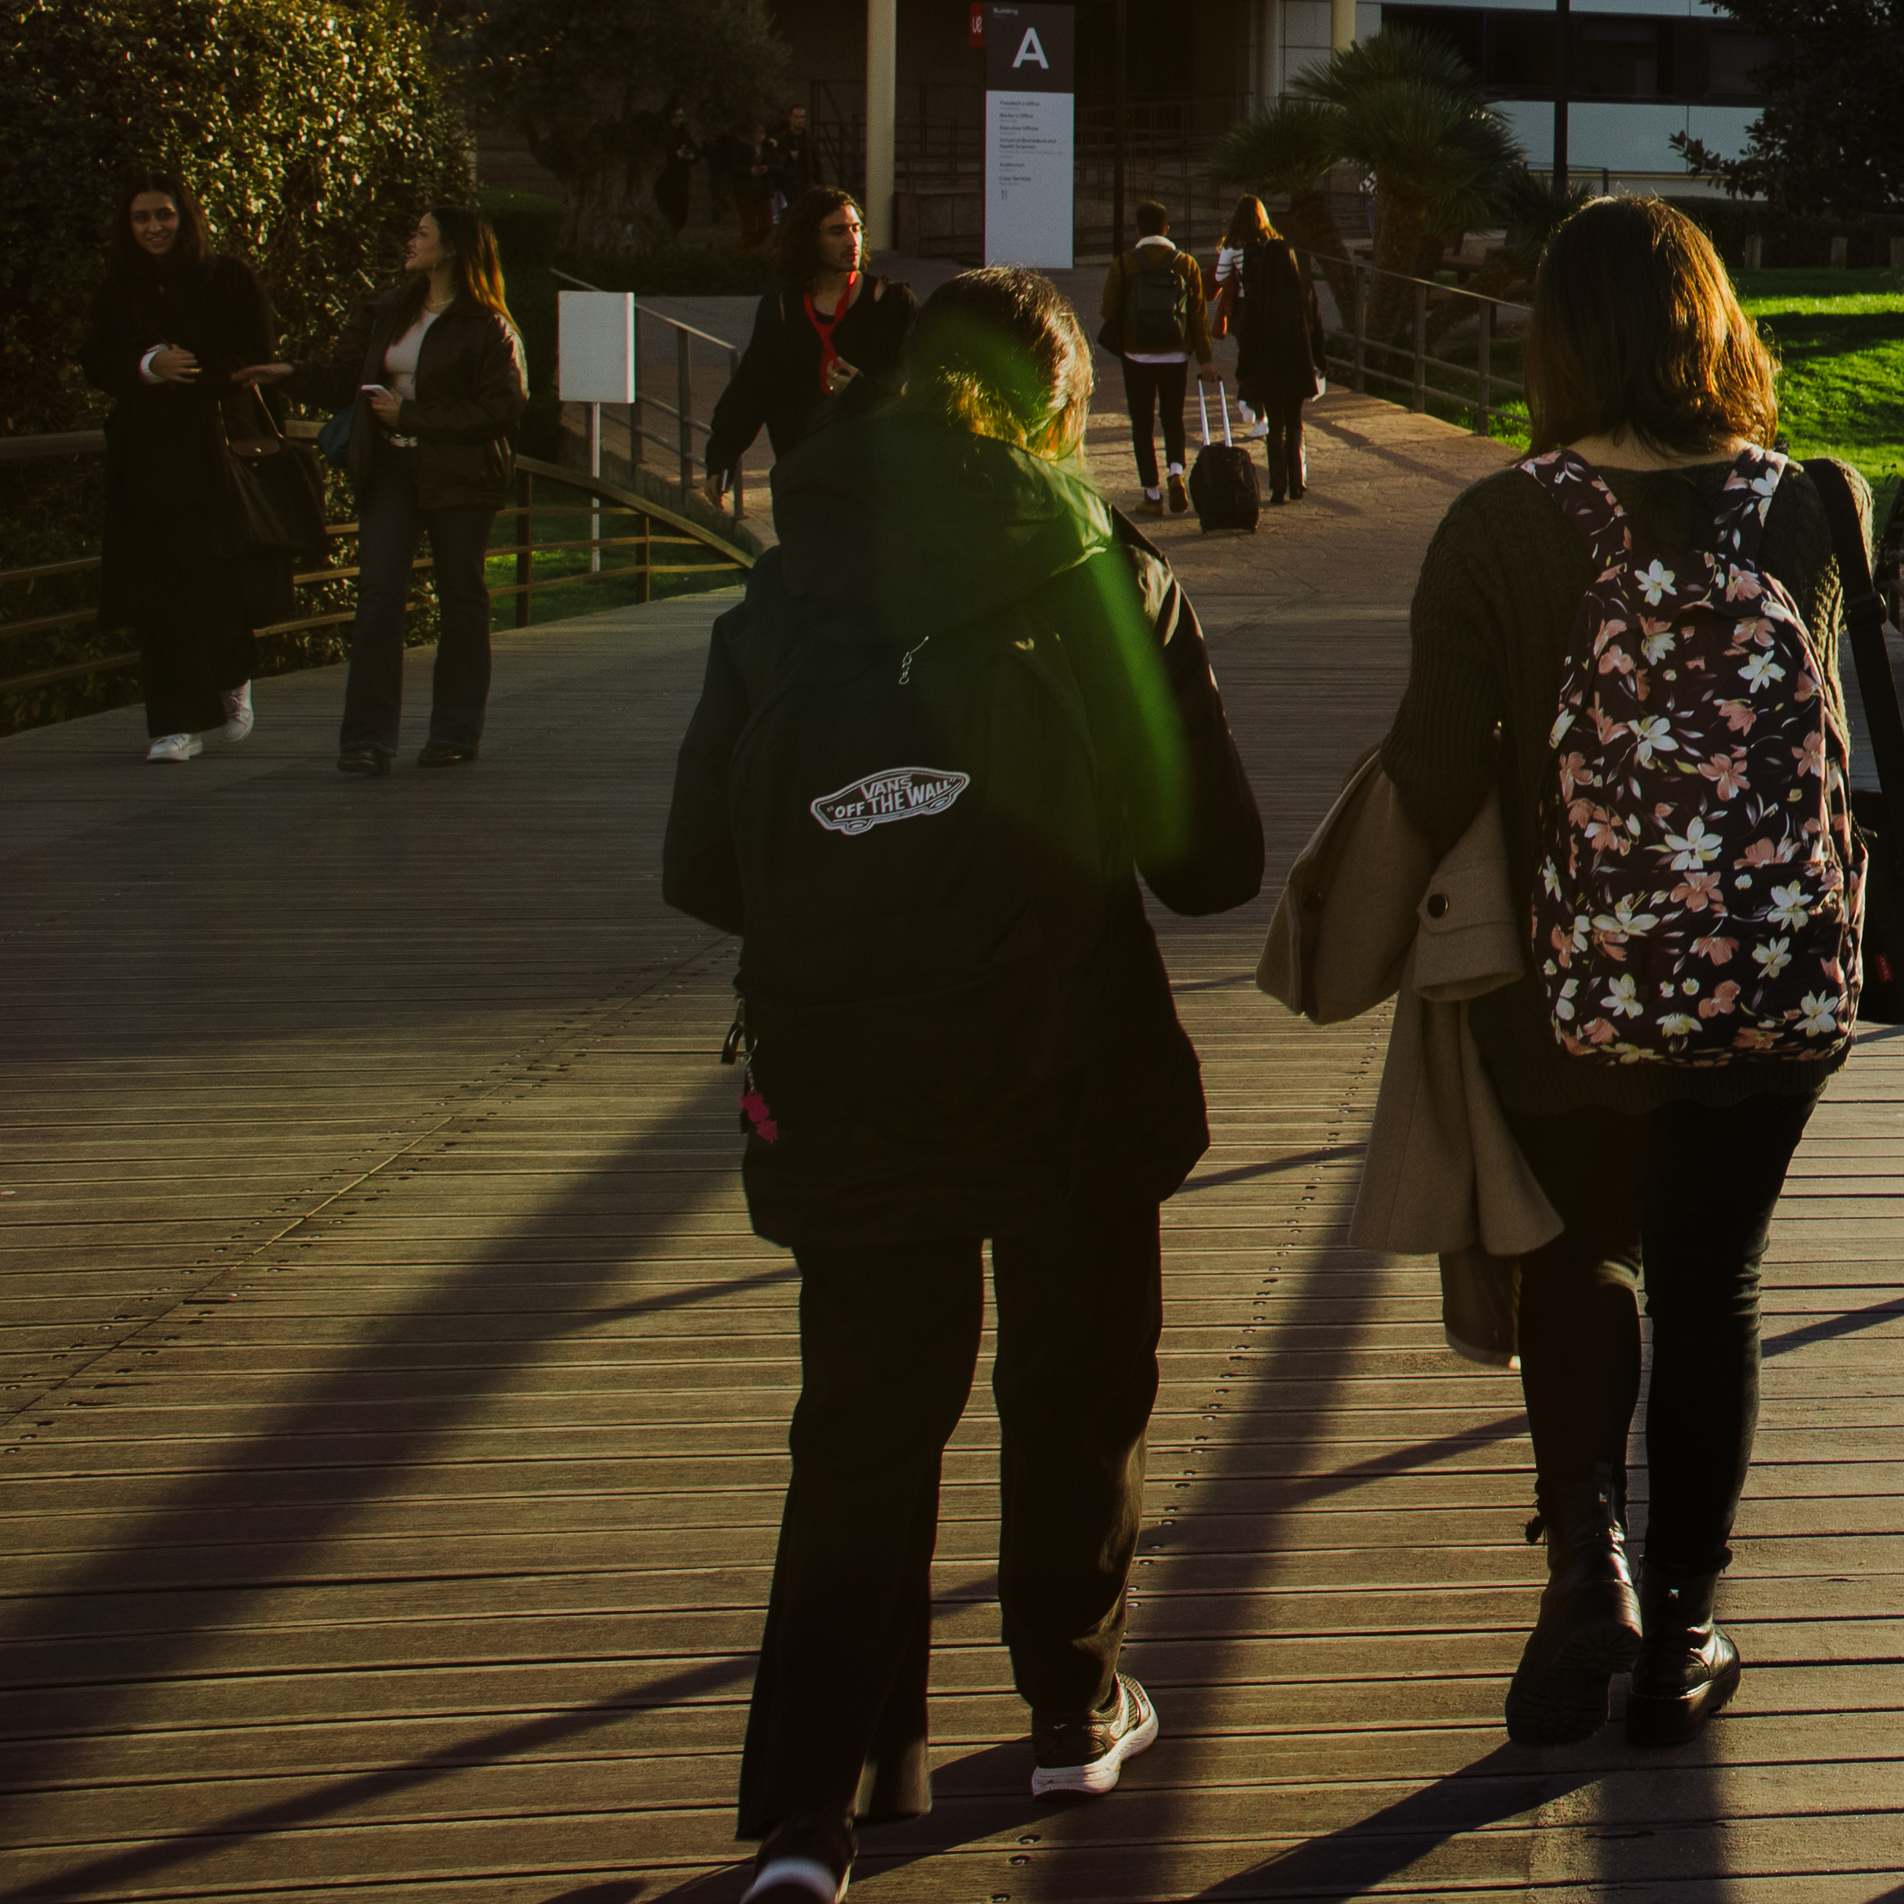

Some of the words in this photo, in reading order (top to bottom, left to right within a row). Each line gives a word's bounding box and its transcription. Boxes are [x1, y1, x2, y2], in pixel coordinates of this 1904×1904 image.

[1012, 27, 1049, 69] A
[860, 774, 913, 800] VANS
[867, 791, 905, 814] THE
